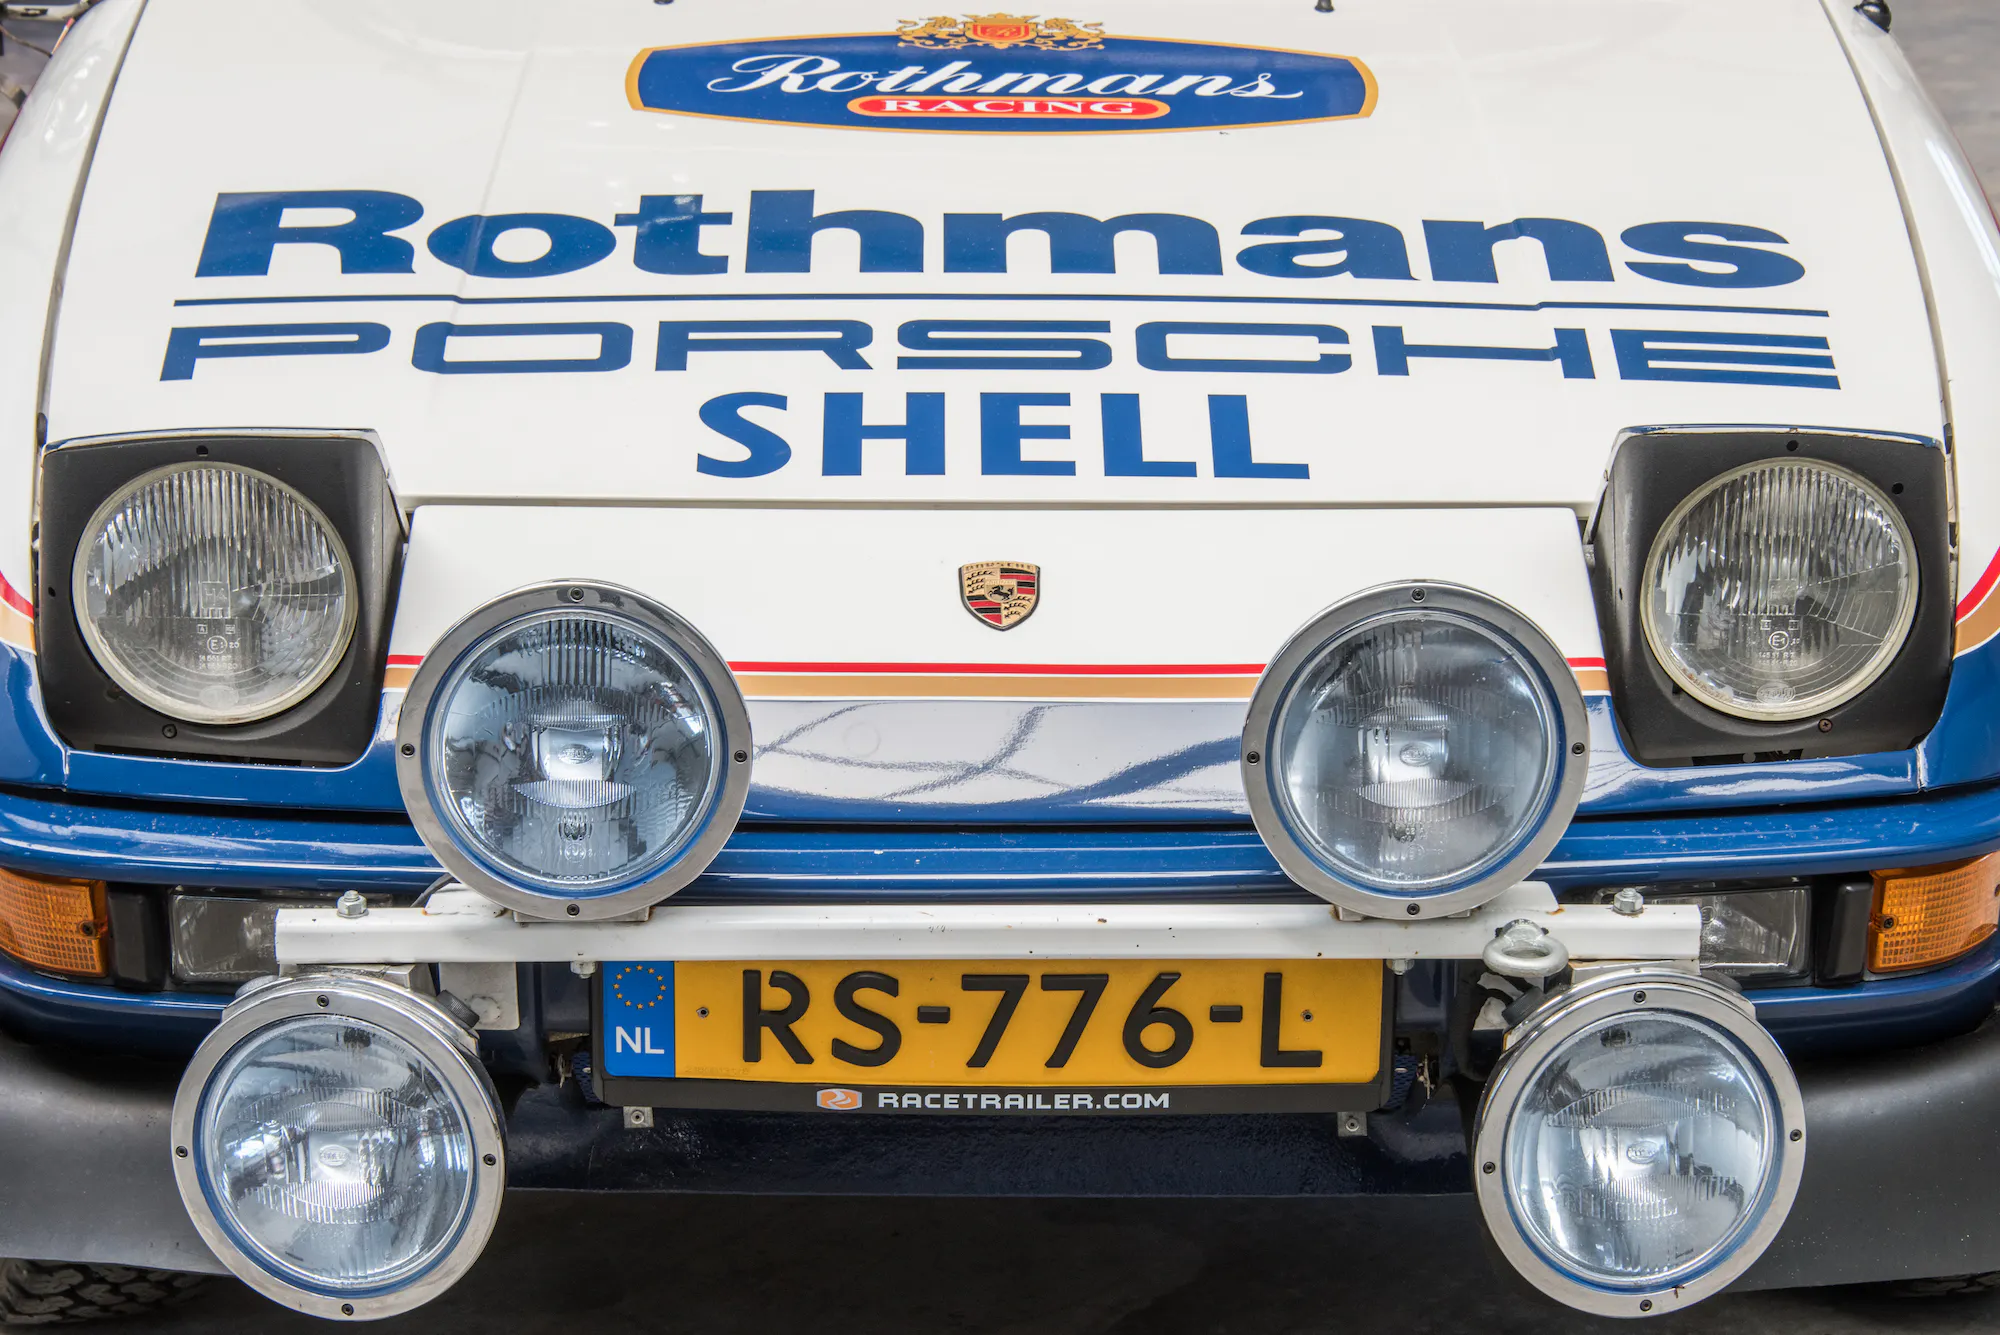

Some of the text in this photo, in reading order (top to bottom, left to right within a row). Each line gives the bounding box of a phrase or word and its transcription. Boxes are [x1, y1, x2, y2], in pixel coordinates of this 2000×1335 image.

[706, 54, 1304, 98] Rothmans
[881, 100, 1137, 114] RACING
[195, 189, 1804, 289] Rothmans
[160, 320, 1841, 391] PORSCHE
[697, 391, 1311, 480] SHELL
[615, 1026, 665, 1055] NL
[742, 969, 1323, 1069] RS-776-L
[878, 1092, 1170, 1110] RACETRAILER.COM
